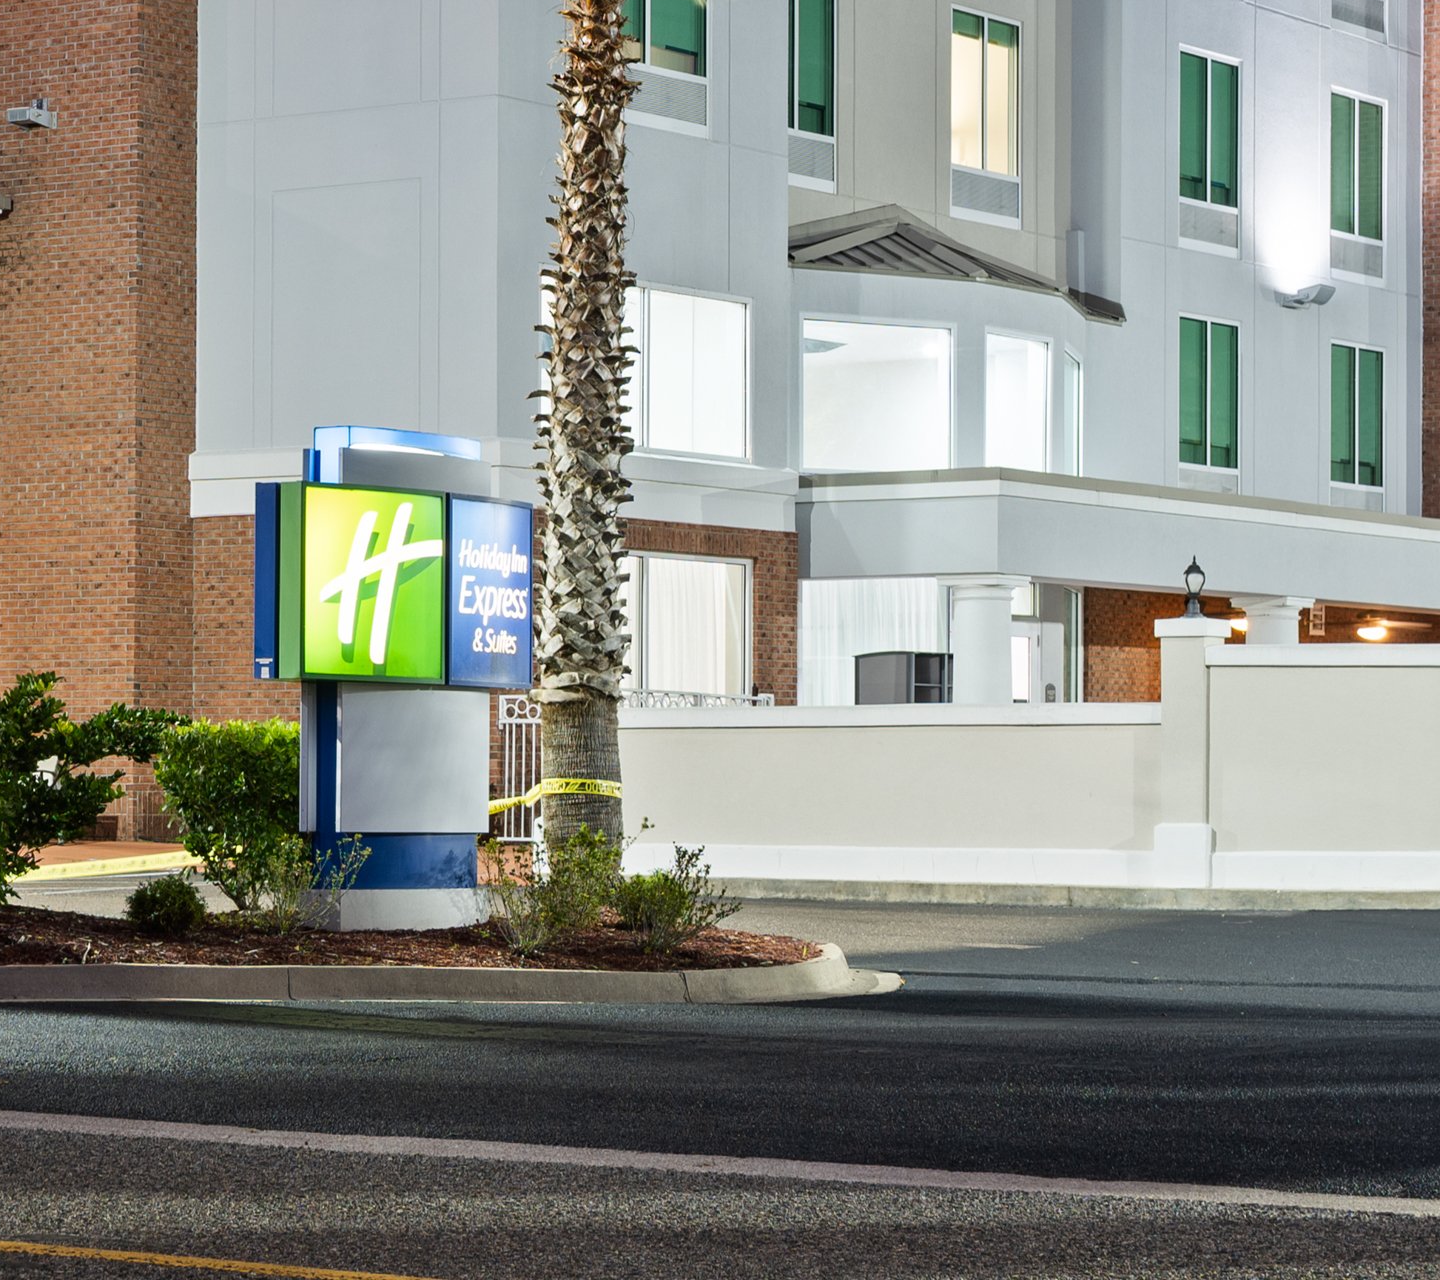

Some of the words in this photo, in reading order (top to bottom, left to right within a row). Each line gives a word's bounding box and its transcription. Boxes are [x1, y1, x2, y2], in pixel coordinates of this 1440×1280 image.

[458, 538, 511, 579] Holiday
[511, 544, 528, 574] Inn
[458, 575, 528, 627] Express
[472, 627, 484, 653] &
[484, 628, 518, 655] Suites
